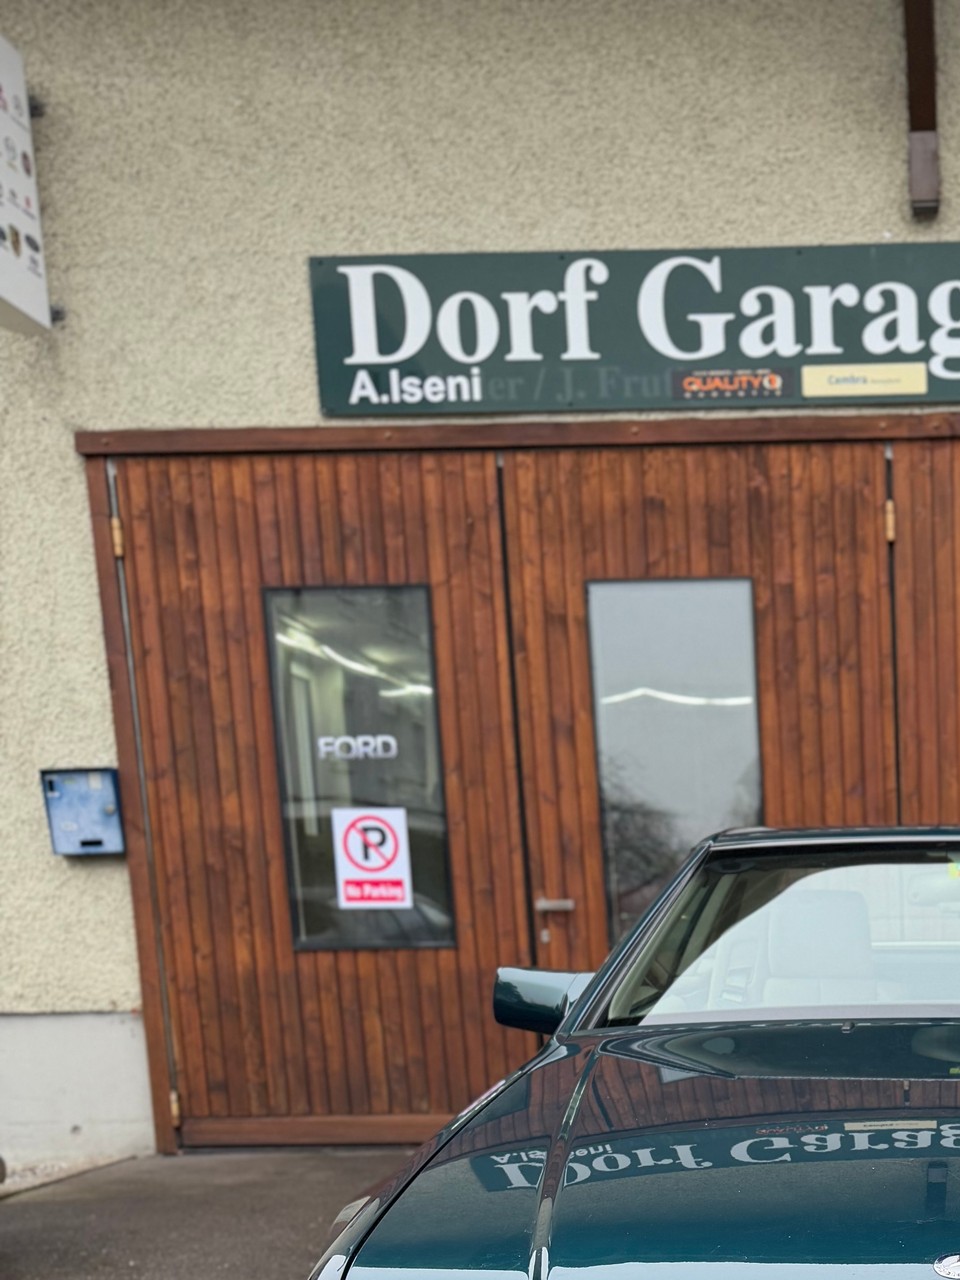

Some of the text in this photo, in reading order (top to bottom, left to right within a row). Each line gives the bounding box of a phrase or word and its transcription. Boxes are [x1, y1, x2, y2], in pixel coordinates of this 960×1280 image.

[337, 257, 609, 366] Dorf
[349, 366, 483, 404] A.Iseni
[317, 735, 398, 760] FORD
